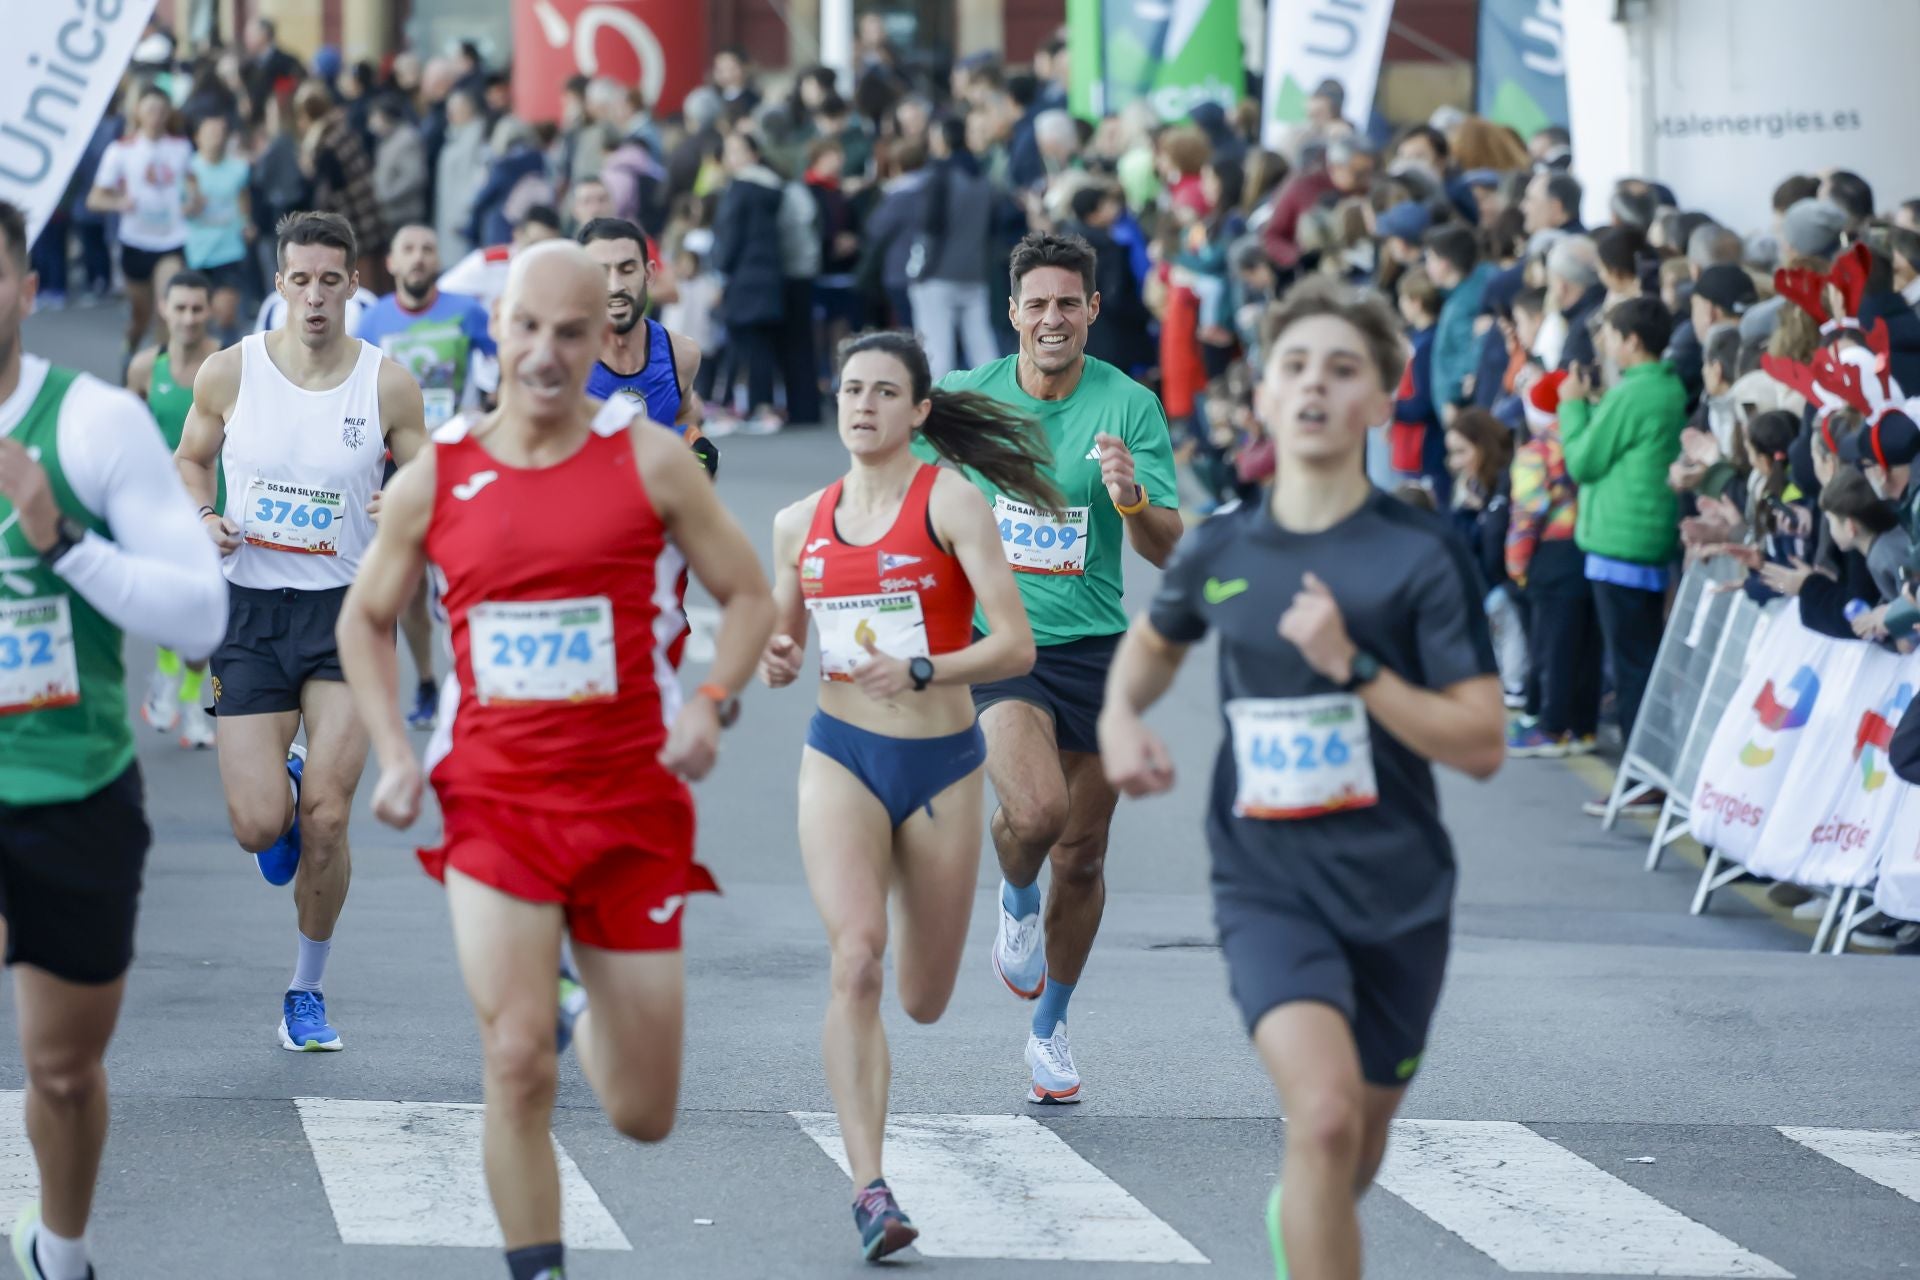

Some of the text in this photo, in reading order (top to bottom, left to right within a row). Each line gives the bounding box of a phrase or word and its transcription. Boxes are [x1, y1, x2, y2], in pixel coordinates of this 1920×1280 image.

[344, 417, 366, 426] MILER
[267, 483, 341, 500] 55 SAN SILVESTRE
[255, 497, 333, 530] 3760
[1017, 505, 1036, 517] SAN
[999, 518, 1078, 550] 4209
[839, 601, 859, 610] SAN
[861, 595, 912, 608] SILVESTRE
[854, 618, 877, 647] 6
[0, 630, 53, 670] 32
[490, 630, 593, 667] 2974
